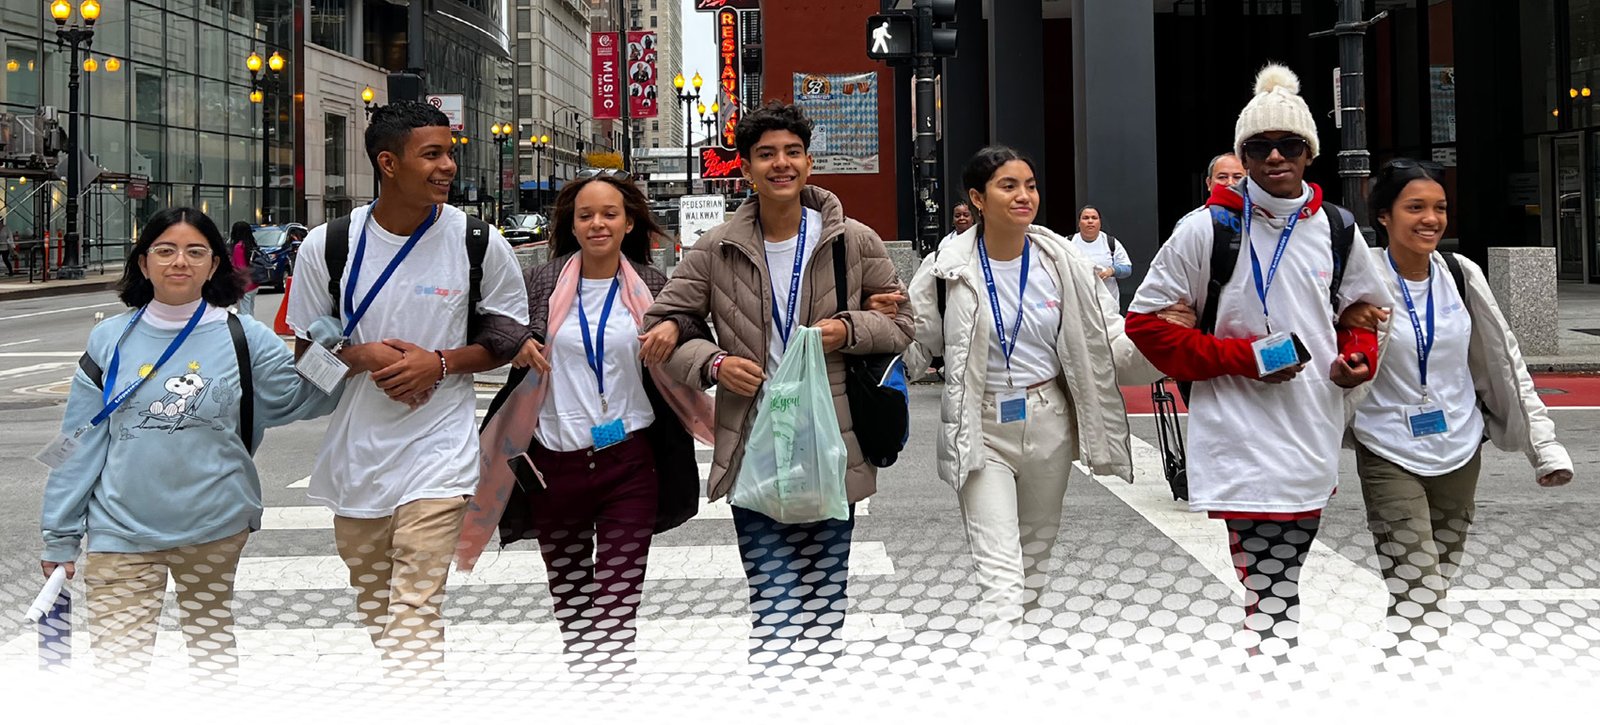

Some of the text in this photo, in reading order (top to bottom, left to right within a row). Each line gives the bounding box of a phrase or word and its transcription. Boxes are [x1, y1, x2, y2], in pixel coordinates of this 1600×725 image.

[602, 61, 614, 109] MUSIC
[721, 12, 736, 145] RESTAUNT
[702, 151, 742, 177] Bergh
[681, 200, 723, 209] PEDESTRIAN
[685, 211, 719, 220] WALKWAY
[786, 292, 796, 328] Ambassadors
[991, 292, 1002, 325] Ambassadors
[114, 377, 142, 404] bassadors
